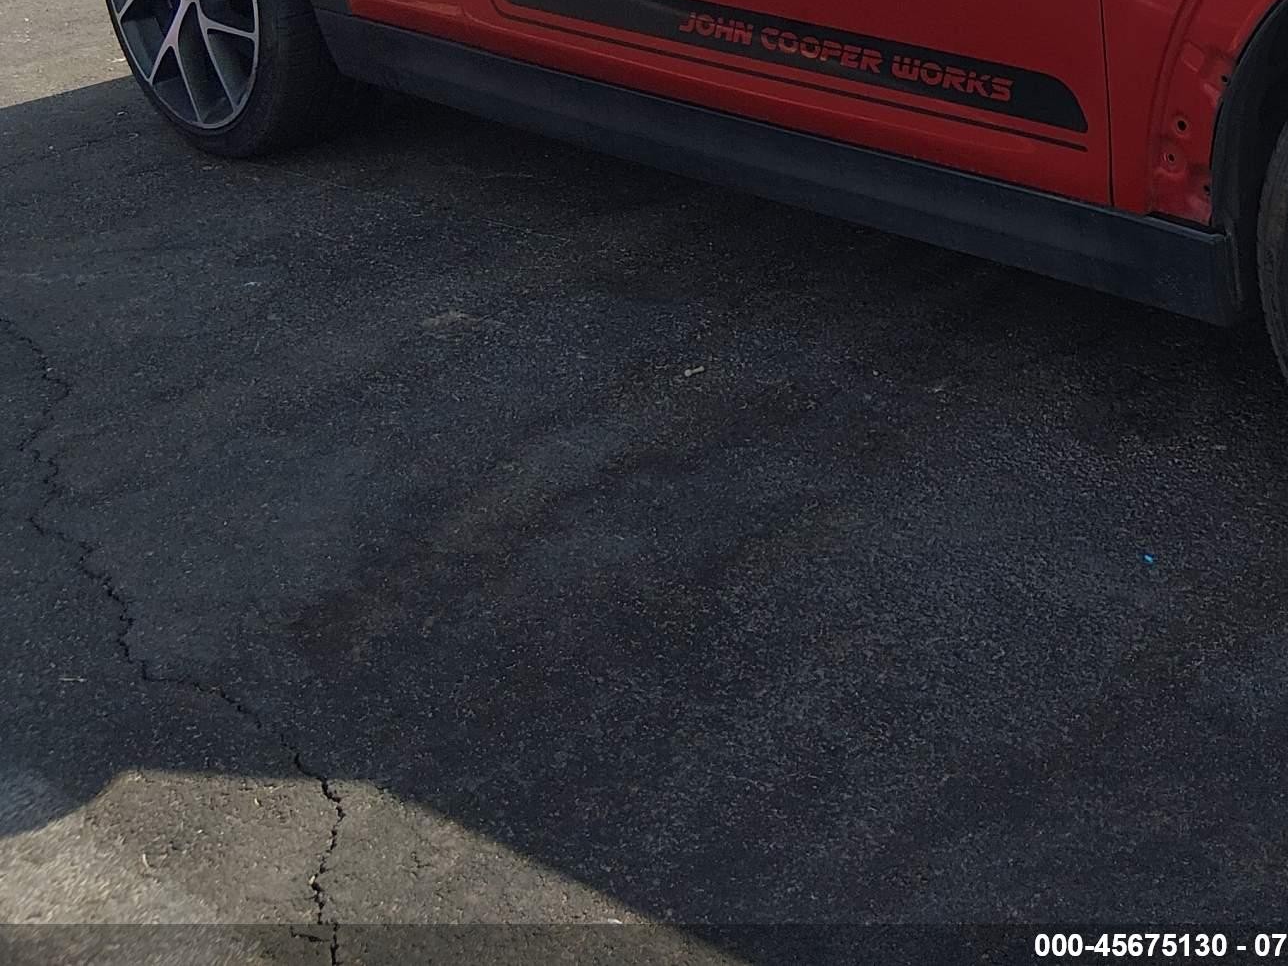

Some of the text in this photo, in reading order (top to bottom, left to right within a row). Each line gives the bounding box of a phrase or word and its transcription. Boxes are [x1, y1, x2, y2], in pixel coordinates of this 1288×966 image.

[679, 11, 1015, 102] JOHN COOPER WORKS
